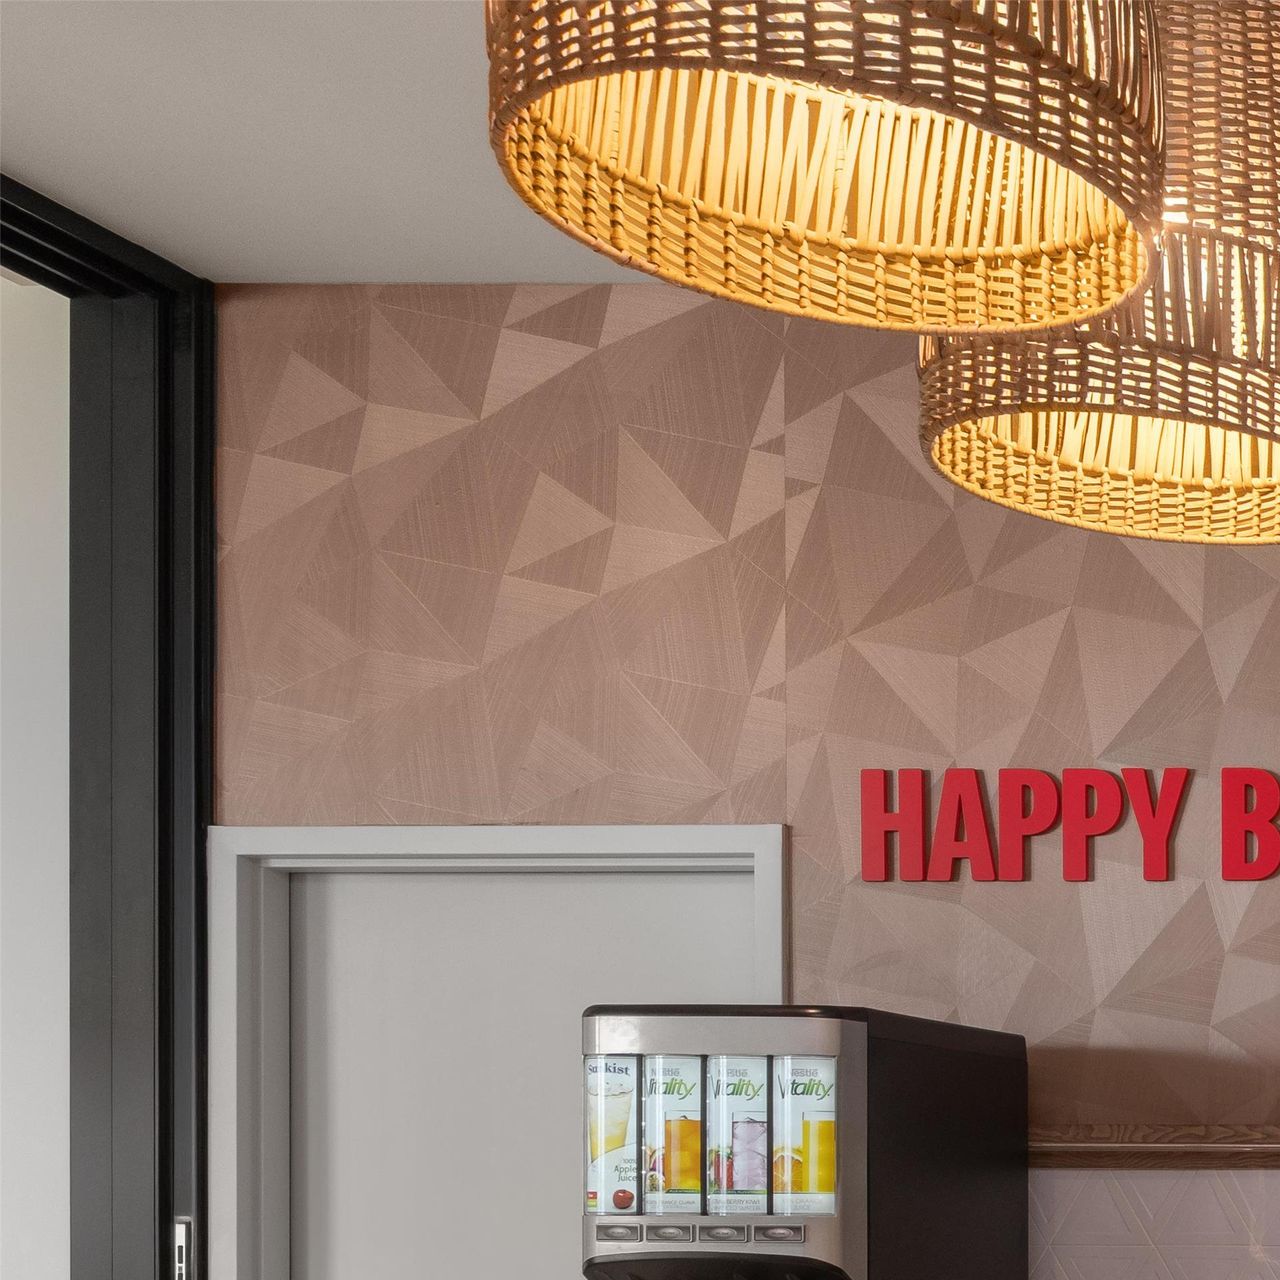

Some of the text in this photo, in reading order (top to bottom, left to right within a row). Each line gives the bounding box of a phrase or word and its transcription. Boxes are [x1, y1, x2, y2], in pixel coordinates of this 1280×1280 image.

[858, 767, 1189, 882] HAPPY
[614, 1165, 637, 1174] Apple
[617, 1174, 638, 1183] Juice
